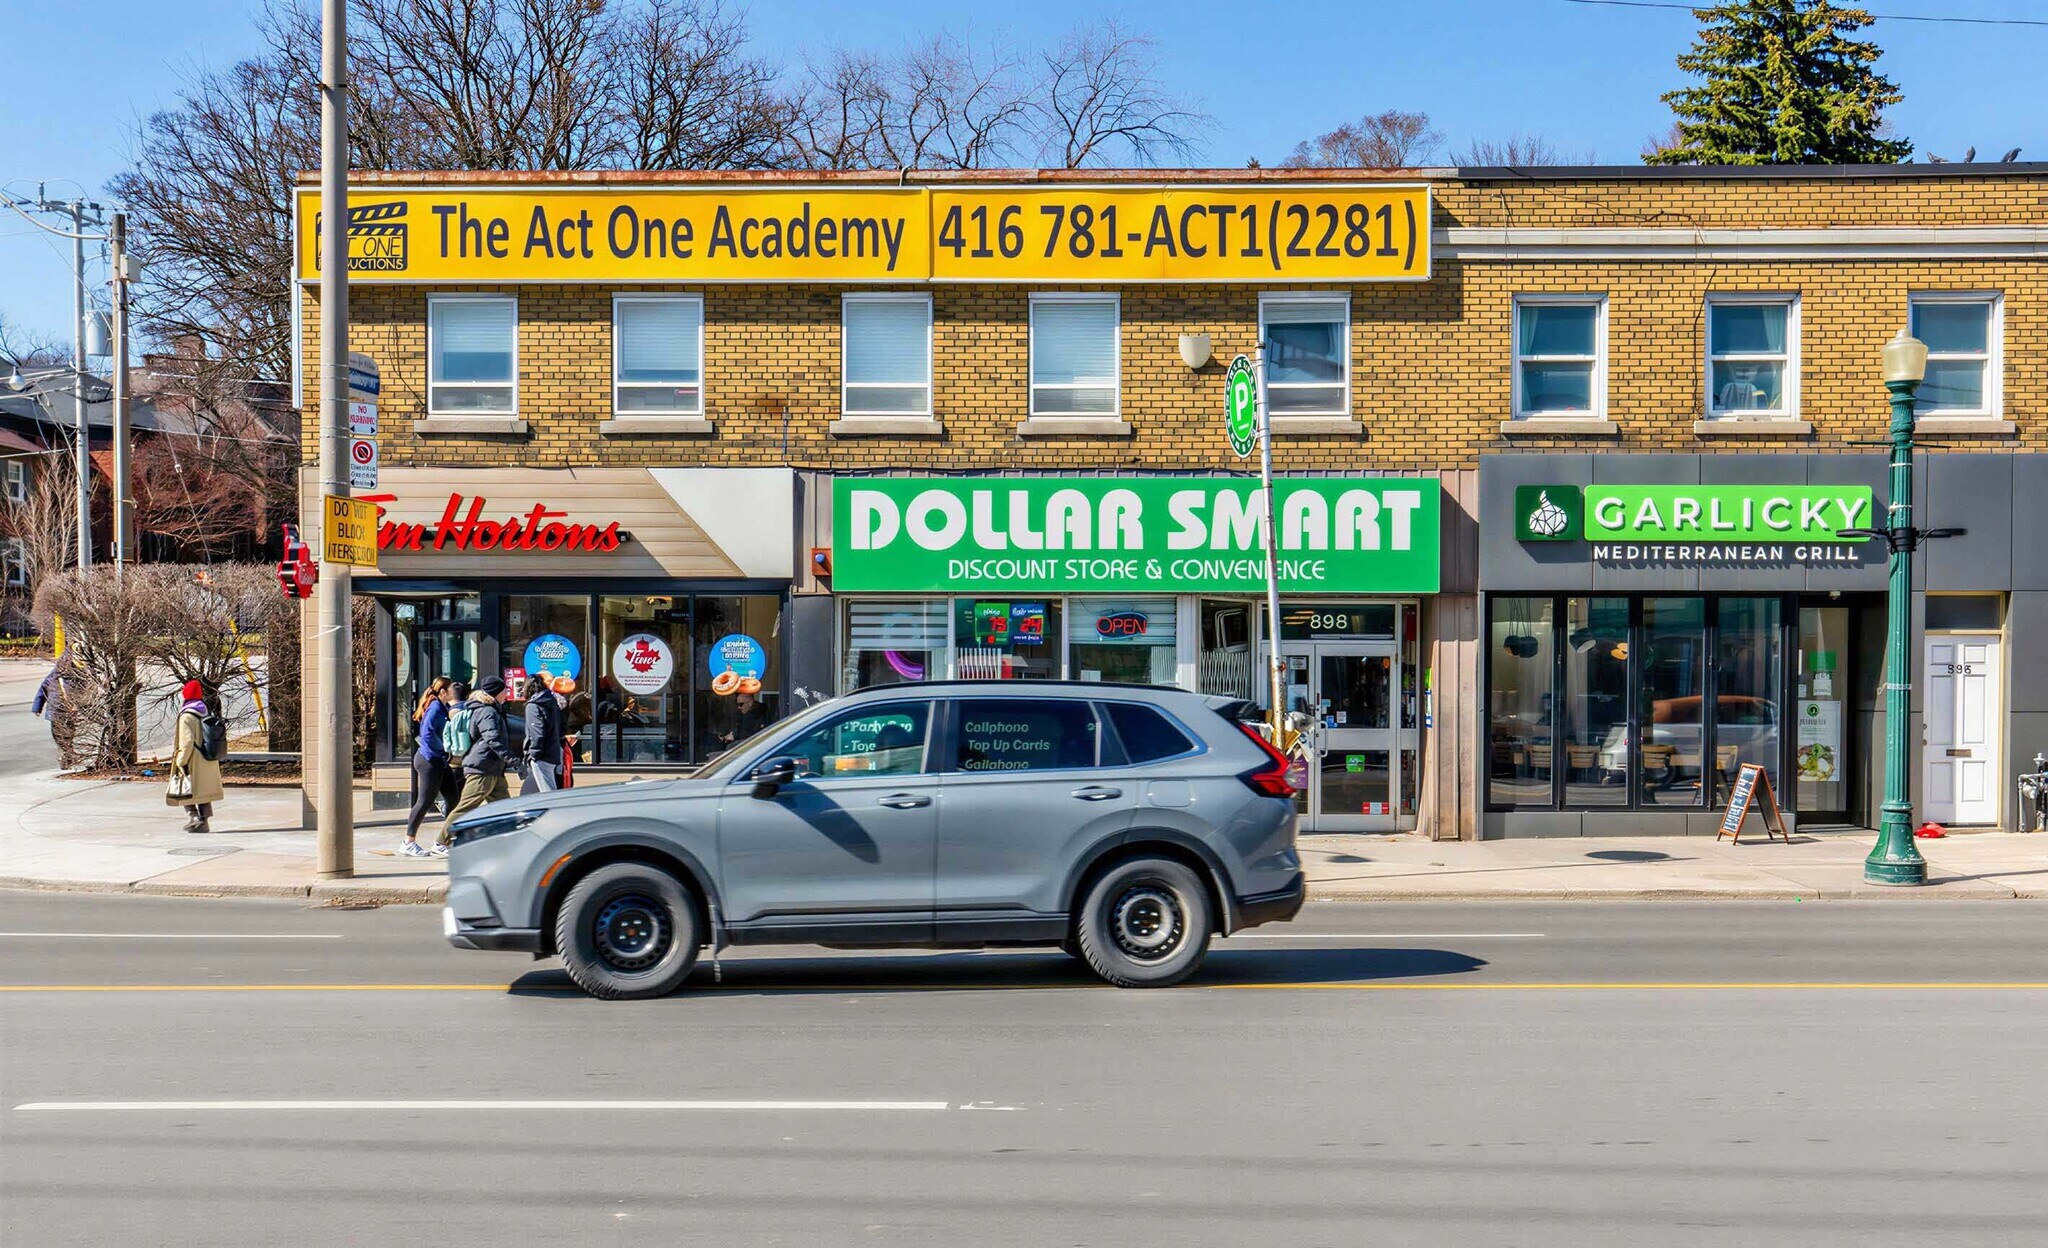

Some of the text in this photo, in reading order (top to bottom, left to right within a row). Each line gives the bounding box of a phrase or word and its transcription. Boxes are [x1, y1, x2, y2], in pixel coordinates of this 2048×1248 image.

[432, 202, 905, 272] The Act One Academy
[938, 200, 1417, 271] 416 781-ACT1(2281)
[363, 237, 401, 257] ONE
[357, 405, 368, 414] NO
[333, 500, 349, 517] DO
[1594, 497, 1867, 530] GARLICKY
[433, 492, 620, 552] Hortons
[850, 488, 1421, 551] DOLLAR SMART
[1594, 545, 1859, 561] MEDITERRANEAN GRILL
[949, 559, 1058, 580] DISCOUNT
[1064, 559, 1138, 580] STORE
[1145, 558, 1163, 580] &
[1095, 615, 1147, 635] OPEN
[1310, 614, 1348, 629] 898
[968, 739, 990, 752] Top
[993, 739, 1010, 752] Up
